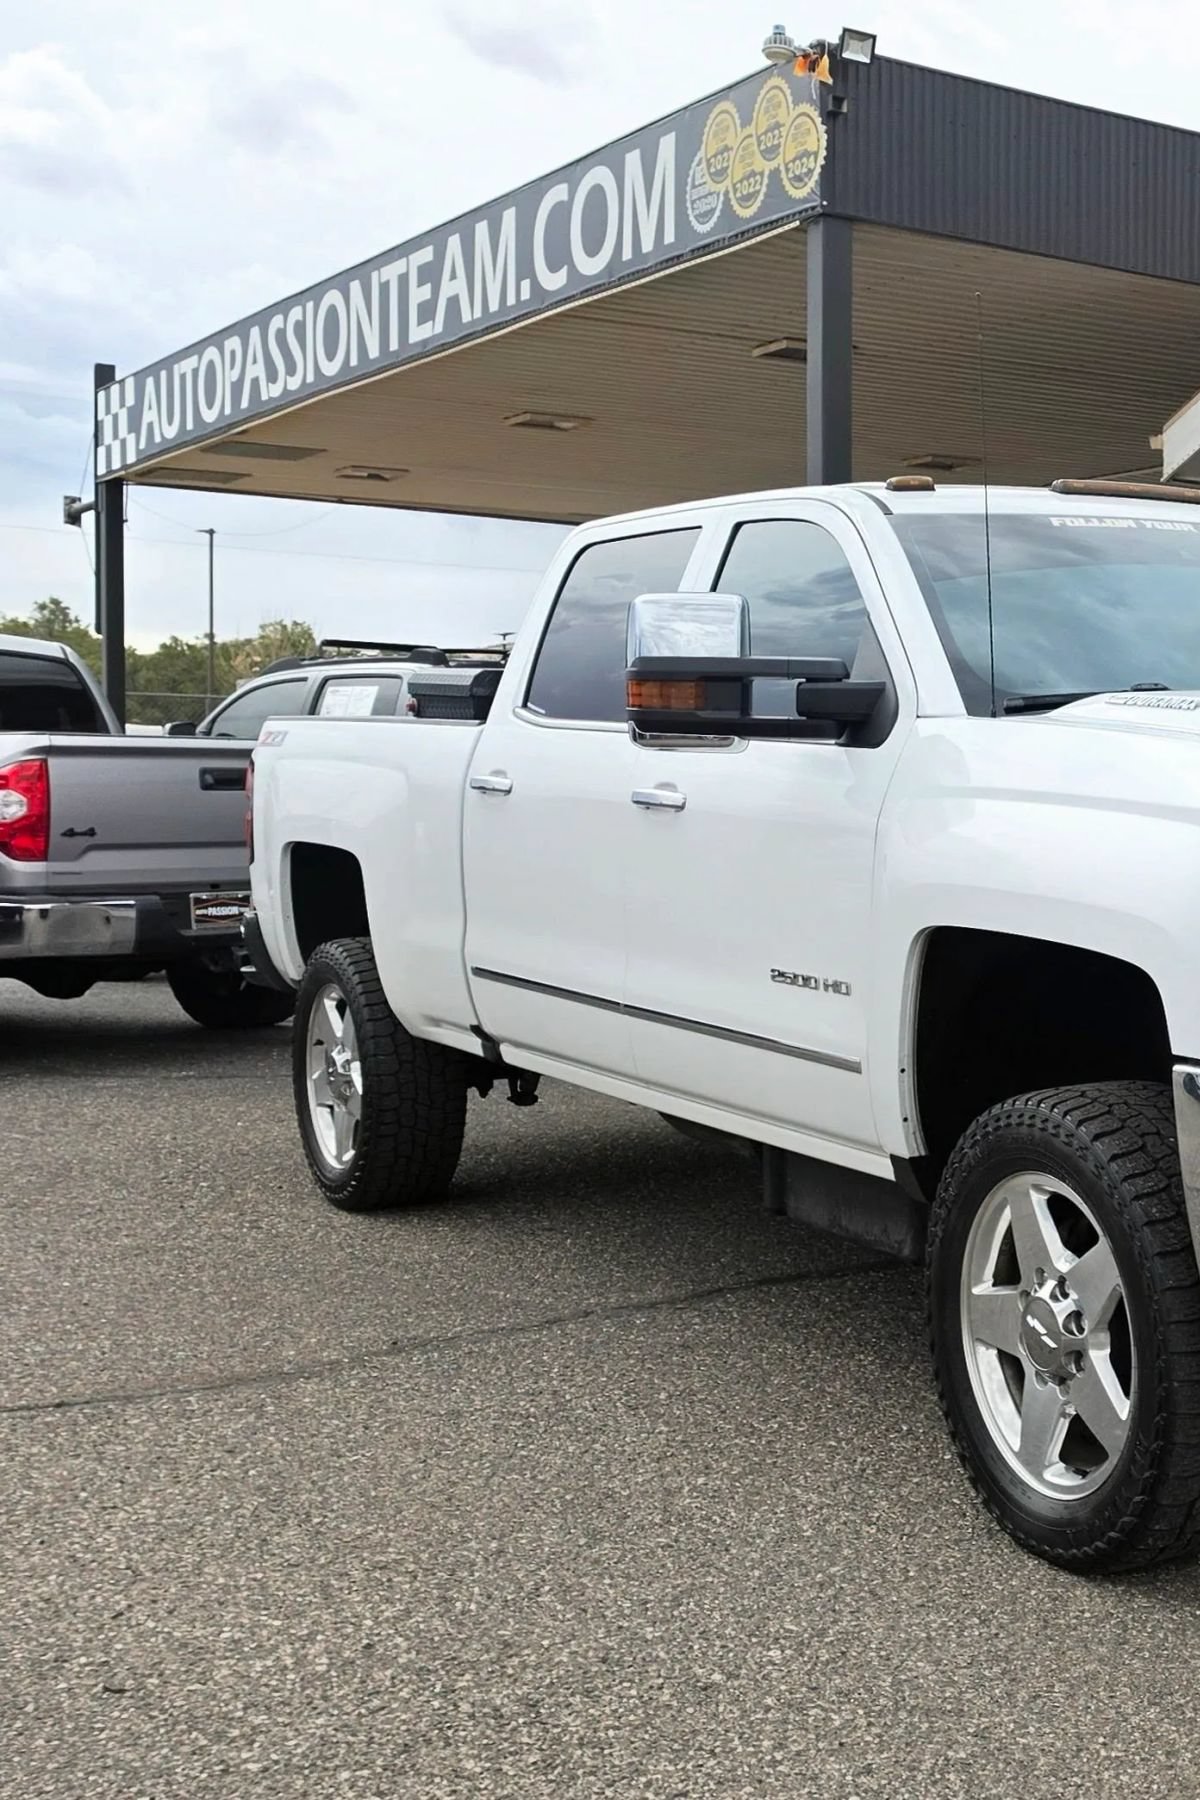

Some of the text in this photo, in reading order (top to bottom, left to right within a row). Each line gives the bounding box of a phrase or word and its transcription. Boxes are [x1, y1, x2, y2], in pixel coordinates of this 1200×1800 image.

[787, 154, 816, 178] 2024
[735, 174, 762, 198] 2022
[138, 131, 677, 450] AUTOPASSIONTEAM.COM
[770, 968, 852, 997] 2500 HD
